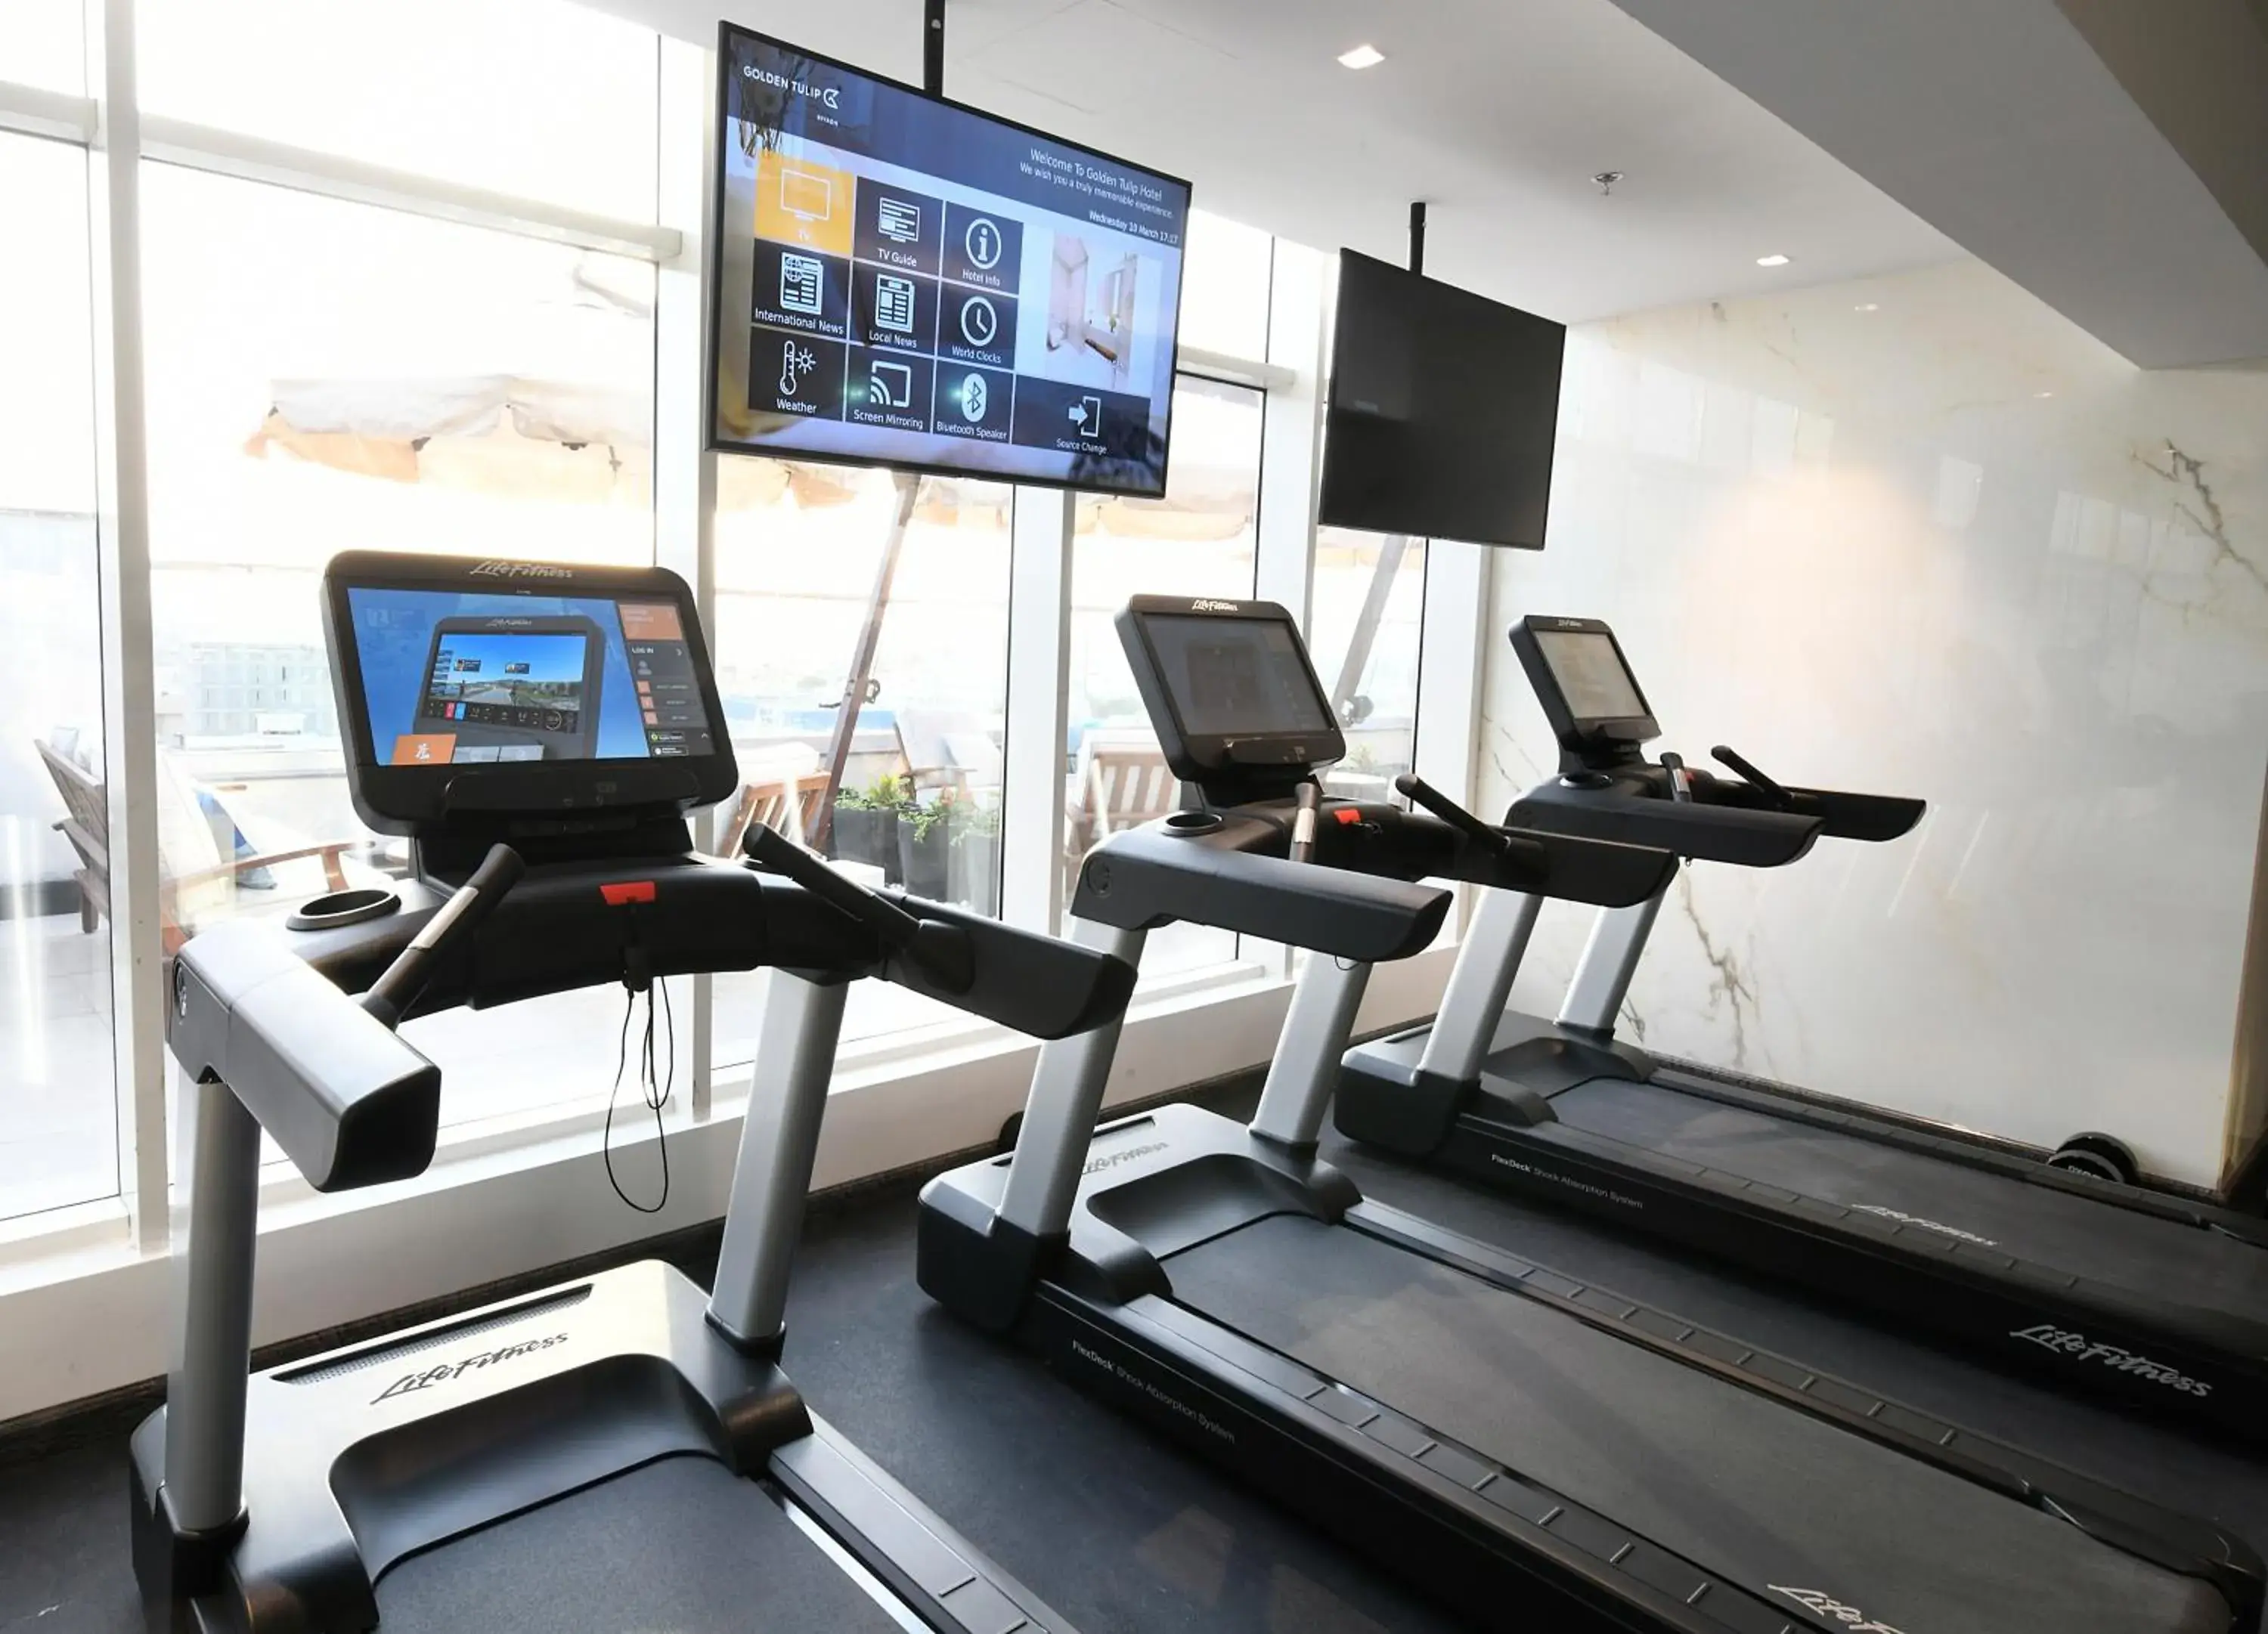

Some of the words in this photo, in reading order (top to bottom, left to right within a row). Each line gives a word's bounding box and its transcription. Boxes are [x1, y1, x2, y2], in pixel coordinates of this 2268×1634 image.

[743, 65, 789, 90] GOLDEN
[791, 80, 821, 99] TULIP
[1020, 161, 1032, 175] We
[1034, 168, 1051, 181] wish
[1053, 174, 1067, 187] you
[1076, 179, 1092, 196] truly
[1030, 148, 1073, 172] Welcome
[1074, 162, 1085, 176] To
[1086, 167, 1117, 187] Golden
[1119, 177, 1139, 196] Tulip
[1139, 184, 1162, 202] Hotel
[1139, 224, 1159, 240] March
[878, 248, 890, 259] TV
[891, 251, 917, 267] Guide
[962, 268, 983, 283] Hotel
[985, 274, 1000, 286] Info
[755, 308, 816, 330] International
[819, 319, 844, 335] News
[869, 330, 891, 342] Local
[894, 335, 917, 348] News
[952, 345, 974, 360] World
[976, 349, 1002, 364] Clocks
[776, 398, 816, 415] Weather
[854, 409, 884, 423] Screen
[885, 413, 923, 430] Mirroring
[937, 421, 974, 436] Bluetooth
[977, 426, 1008, 441] Speaker
[1056, 438, 1080, 451] Source
[1081, 441, 1107, 455] Change
[1492, 1153, 1531, 1172] FlexDeck
[1533, 1167, 1559, 1182] Shock
[1560, 1178, 1608, 1198] Absorption
[1610, 1190, 1644, 1209] System
[1072, 1338, 1114, 1372] FlexDeck
[1117, 1366, 1145, 1390] Shock
[1145, 1382, 1198, 1420] Absorption
[1198, 1413, 1236, 1444] System
